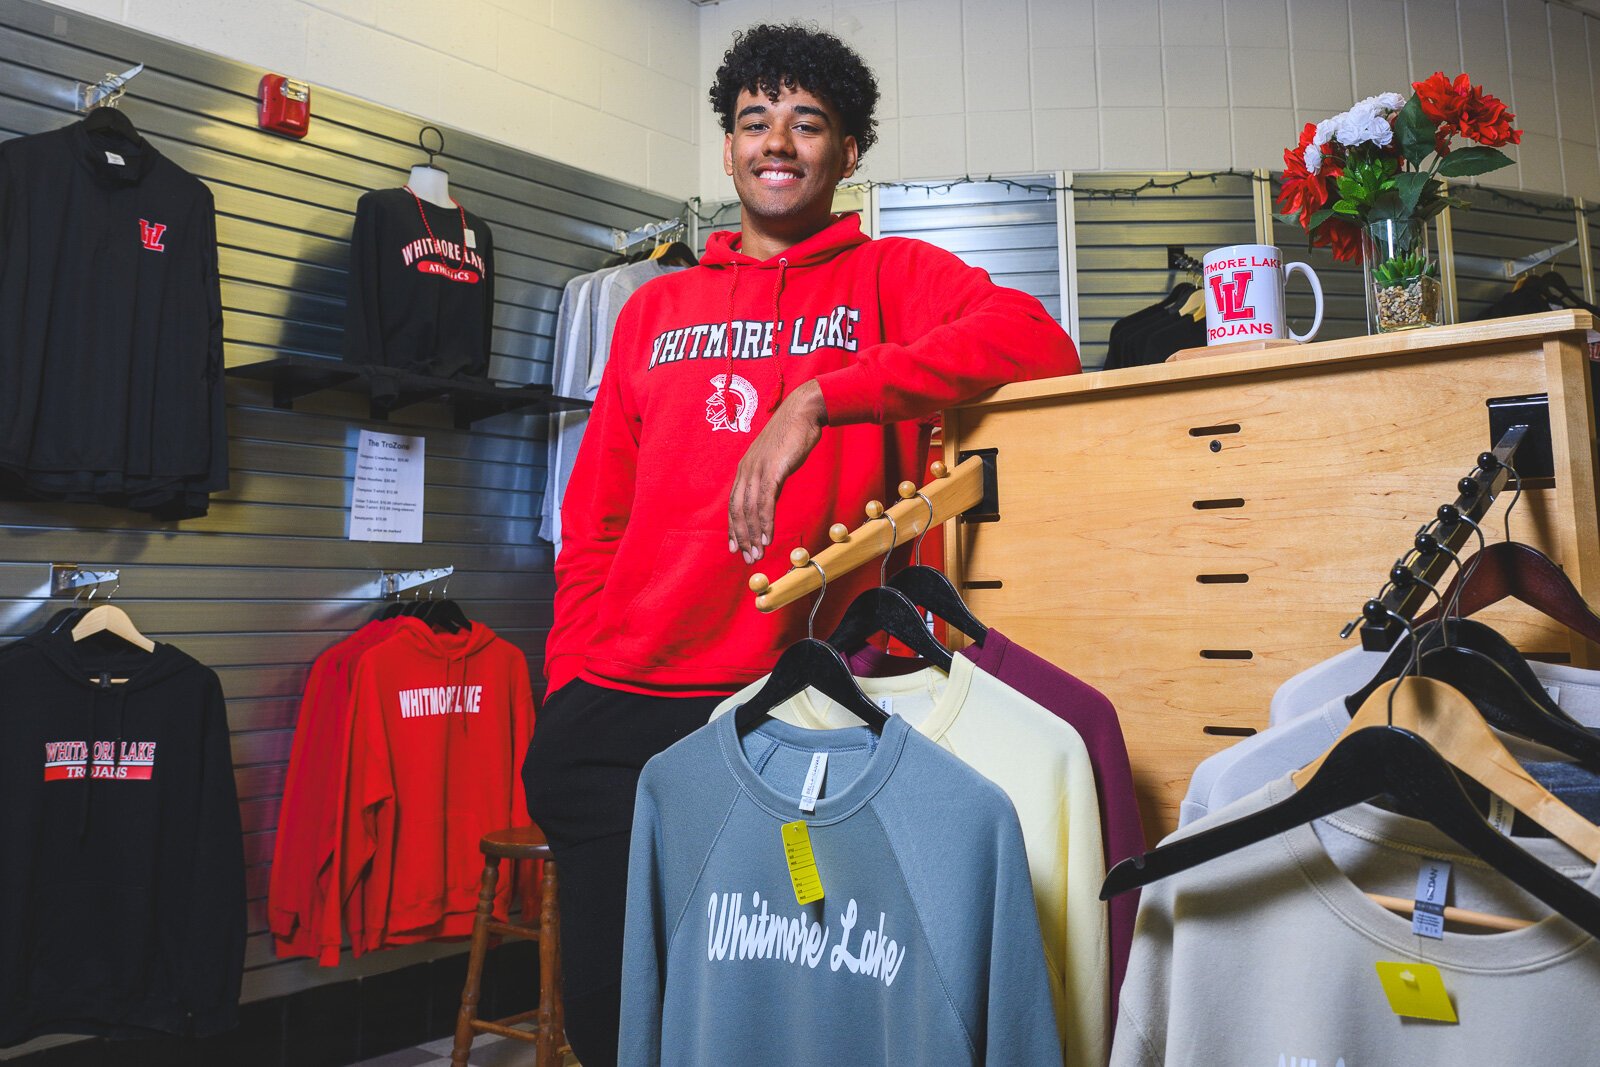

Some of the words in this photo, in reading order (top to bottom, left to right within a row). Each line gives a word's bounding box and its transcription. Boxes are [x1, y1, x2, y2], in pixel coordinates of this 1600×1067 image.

[788, 305, 860, 357] LAKE
[368, 439, 379, 447] The
[119, 741, 156, 762] LAKE
[707, 890, 830, 969] Whitmore
[829, 898, 906, 988] Lake
